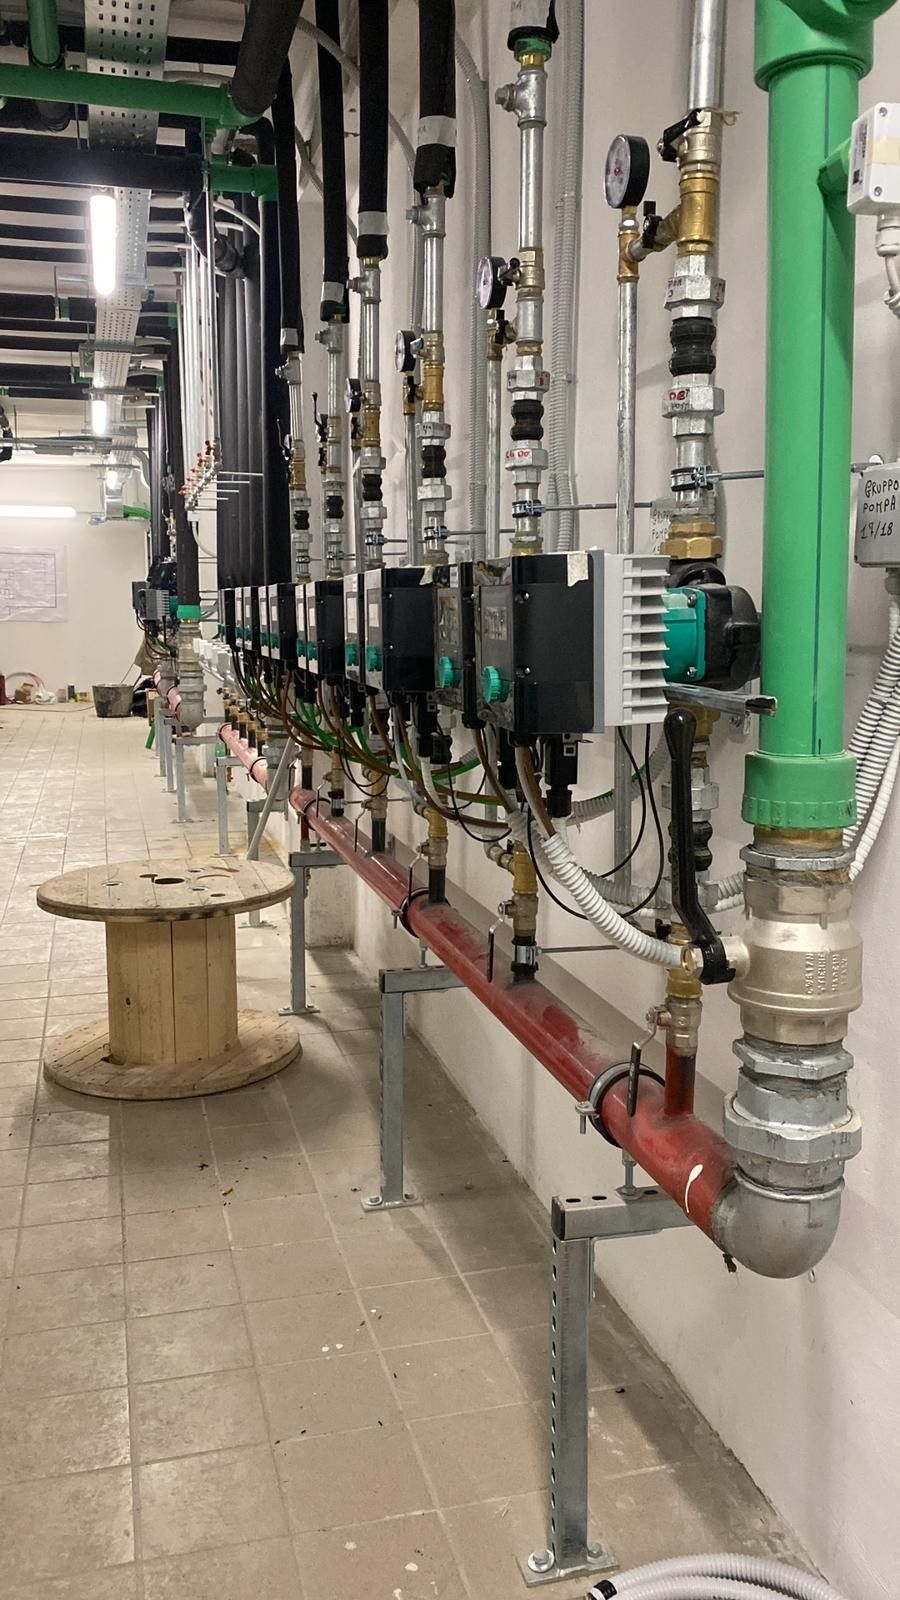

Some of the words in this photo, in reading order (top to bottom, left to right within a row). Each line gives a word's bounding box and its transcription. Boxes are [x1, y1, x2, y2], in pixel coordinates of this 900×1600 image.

[865, 479, 899, 498] GRUPPO
[863, 495, 896, 513] POMPA
[861, 521, 893, 539] 17/18
